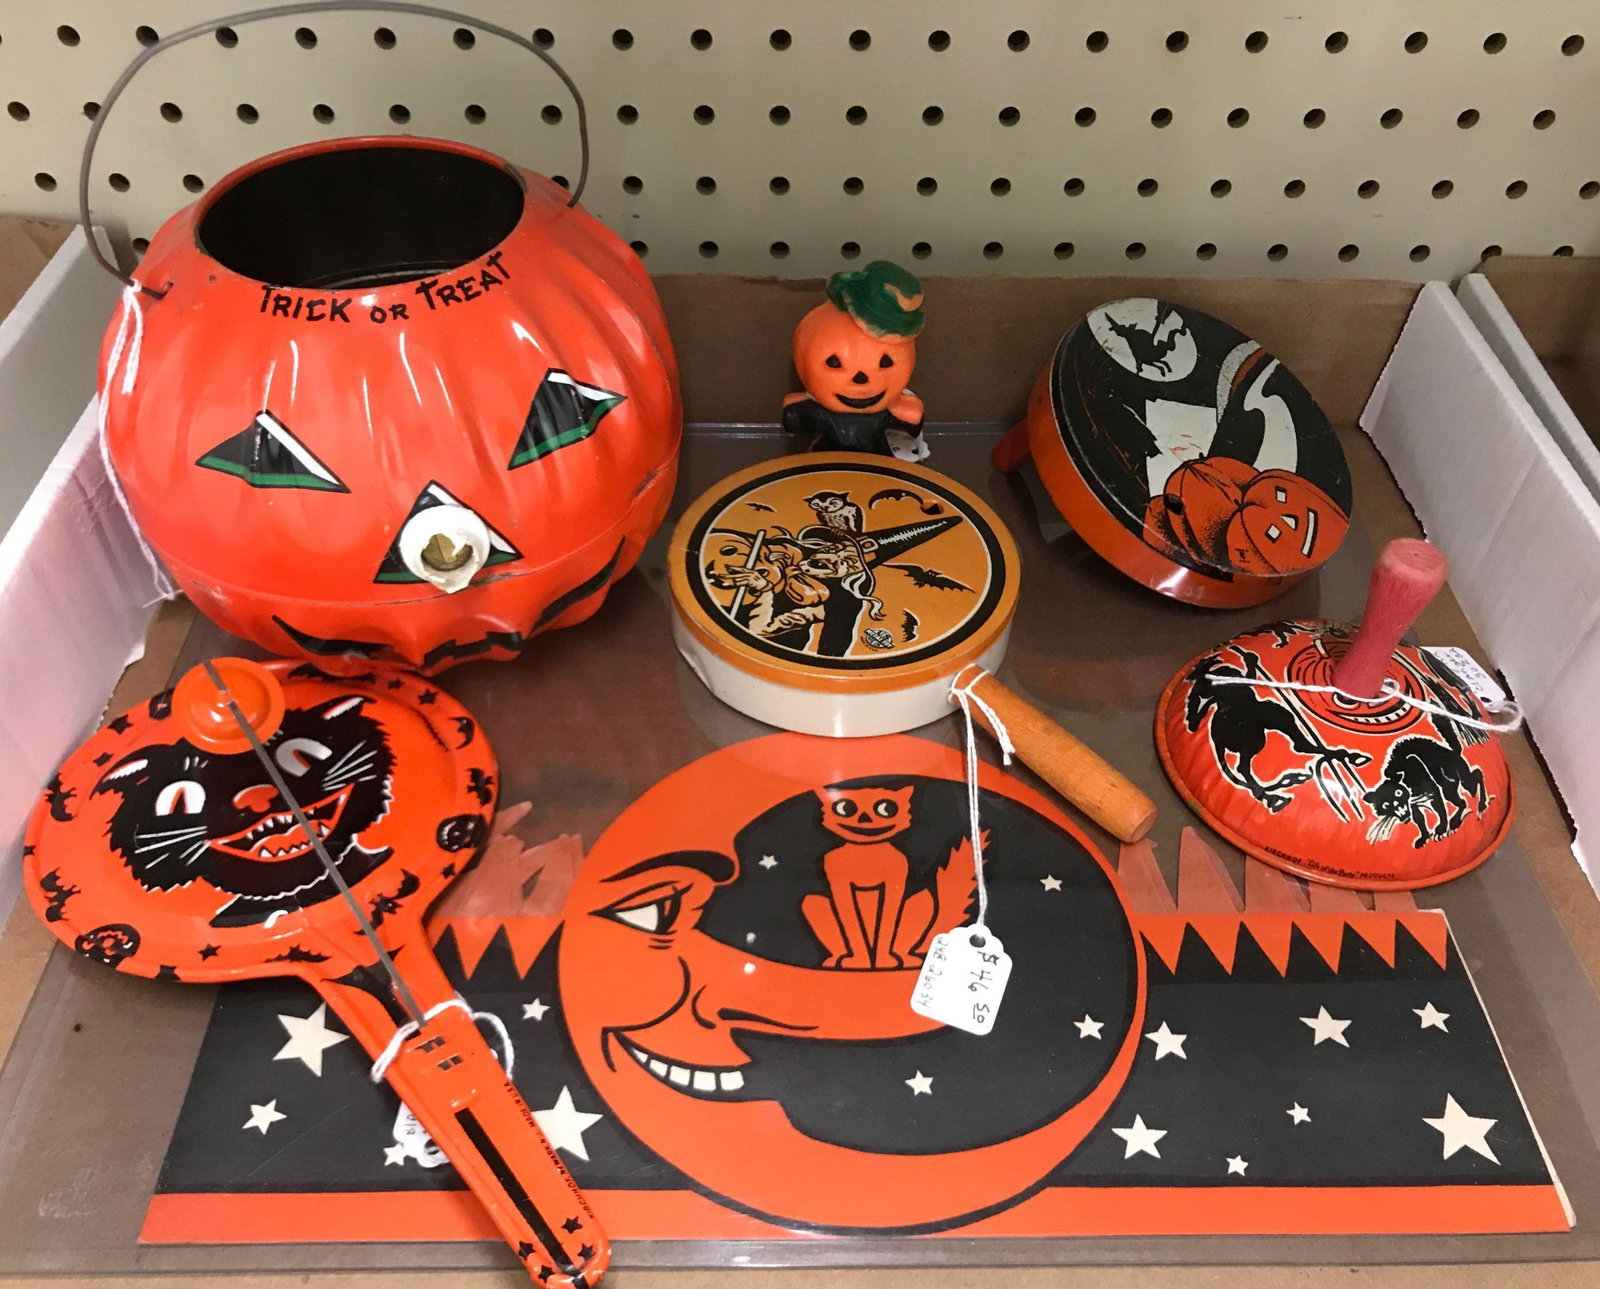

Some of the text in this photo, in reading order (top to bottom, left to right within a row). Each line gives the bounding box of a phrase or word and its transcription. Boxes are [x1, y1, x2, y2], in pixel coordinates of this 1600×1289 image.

[260, 251, 511, 324] TRICK OR TREAT
